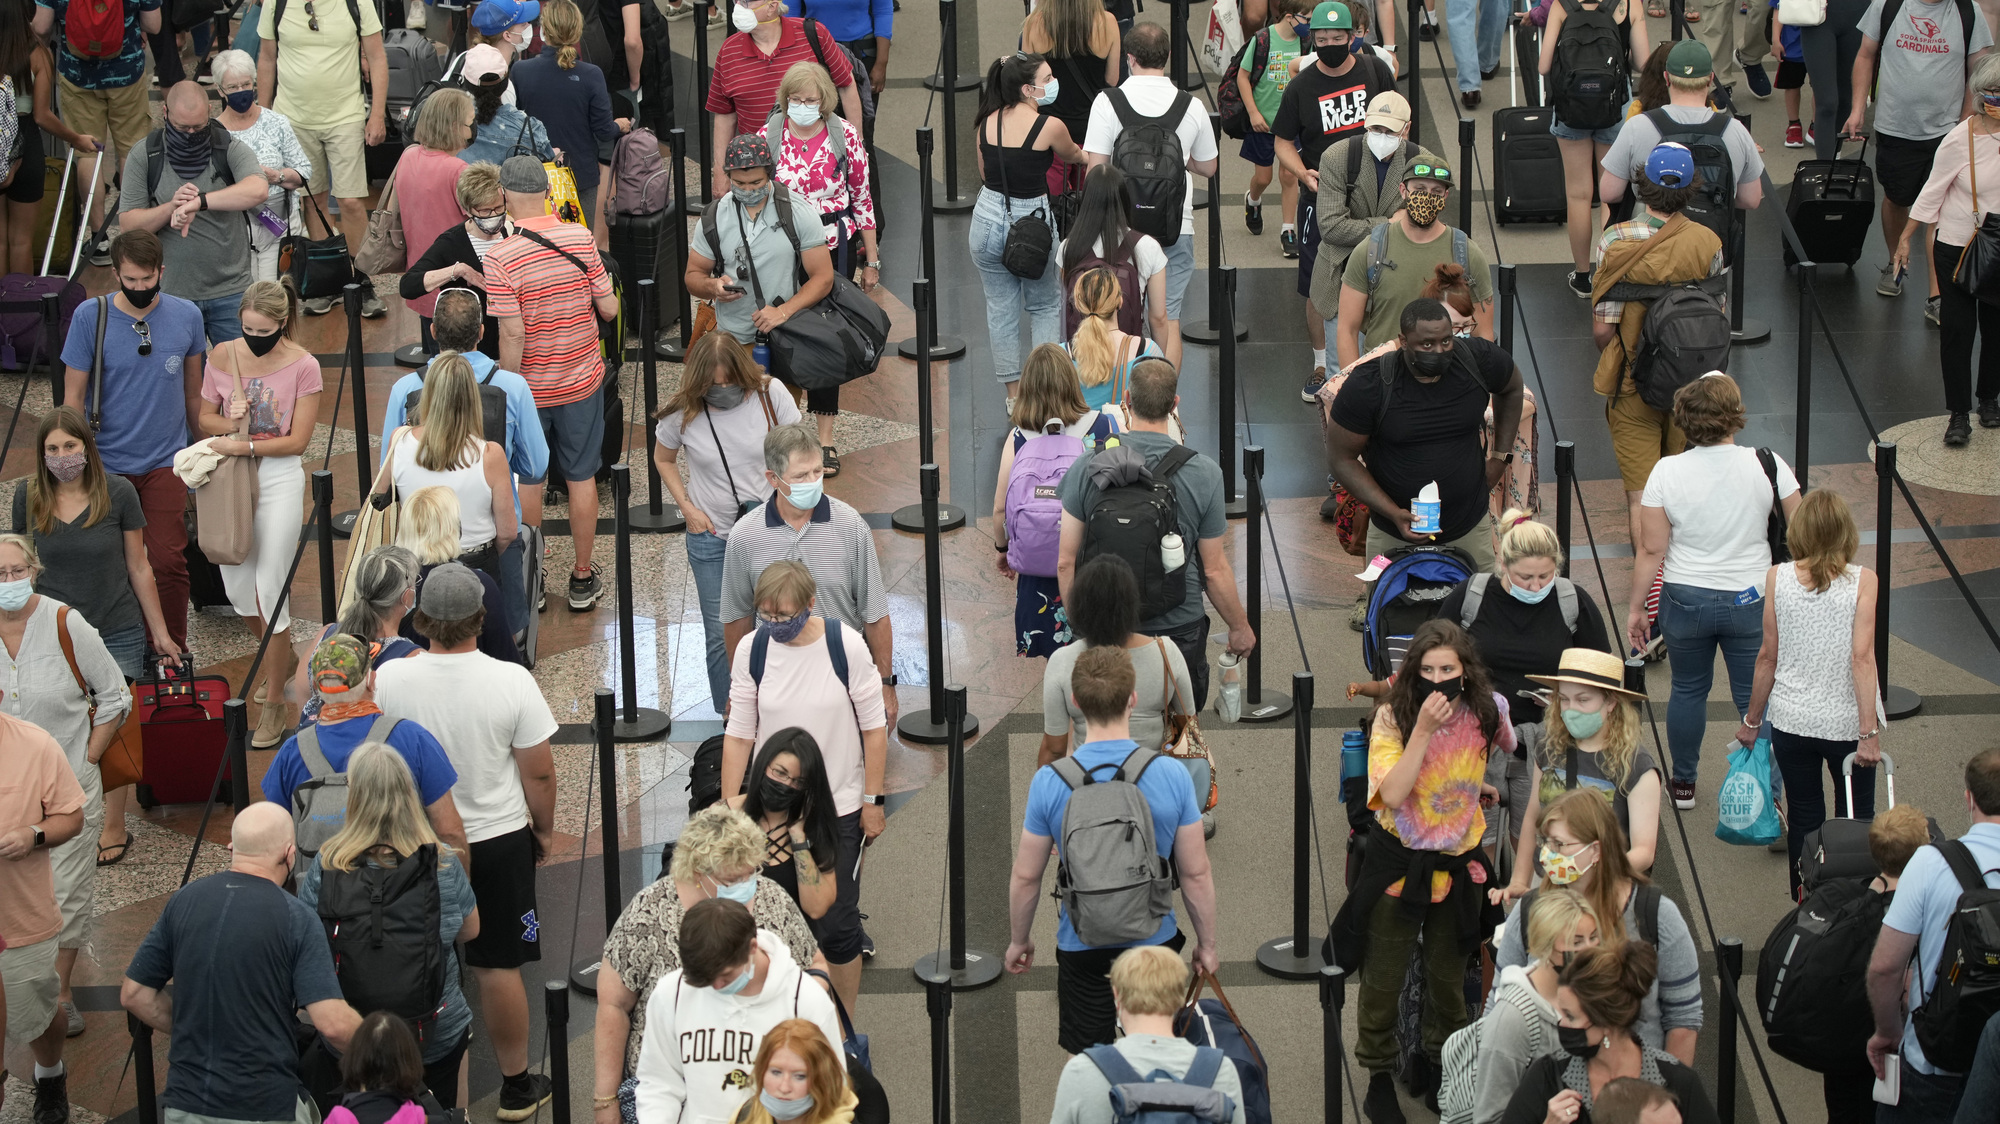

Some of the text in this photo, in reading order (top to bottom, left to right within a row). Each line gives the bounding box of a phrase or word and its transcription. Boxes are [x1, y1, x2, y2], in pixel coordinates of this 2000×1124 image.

[1900, 33, 1919, 42] SODA
[1895, 39, 1950, 54] CARDINALS
[1322, 106, 1366, 132] MCA
[1741, 596, 1753, 604] Here
[1724, 782, 1754, 795] CASH
[1721, 803, 1753, 815] STUFF
[680, 1028, 755, 1065] COLOR
